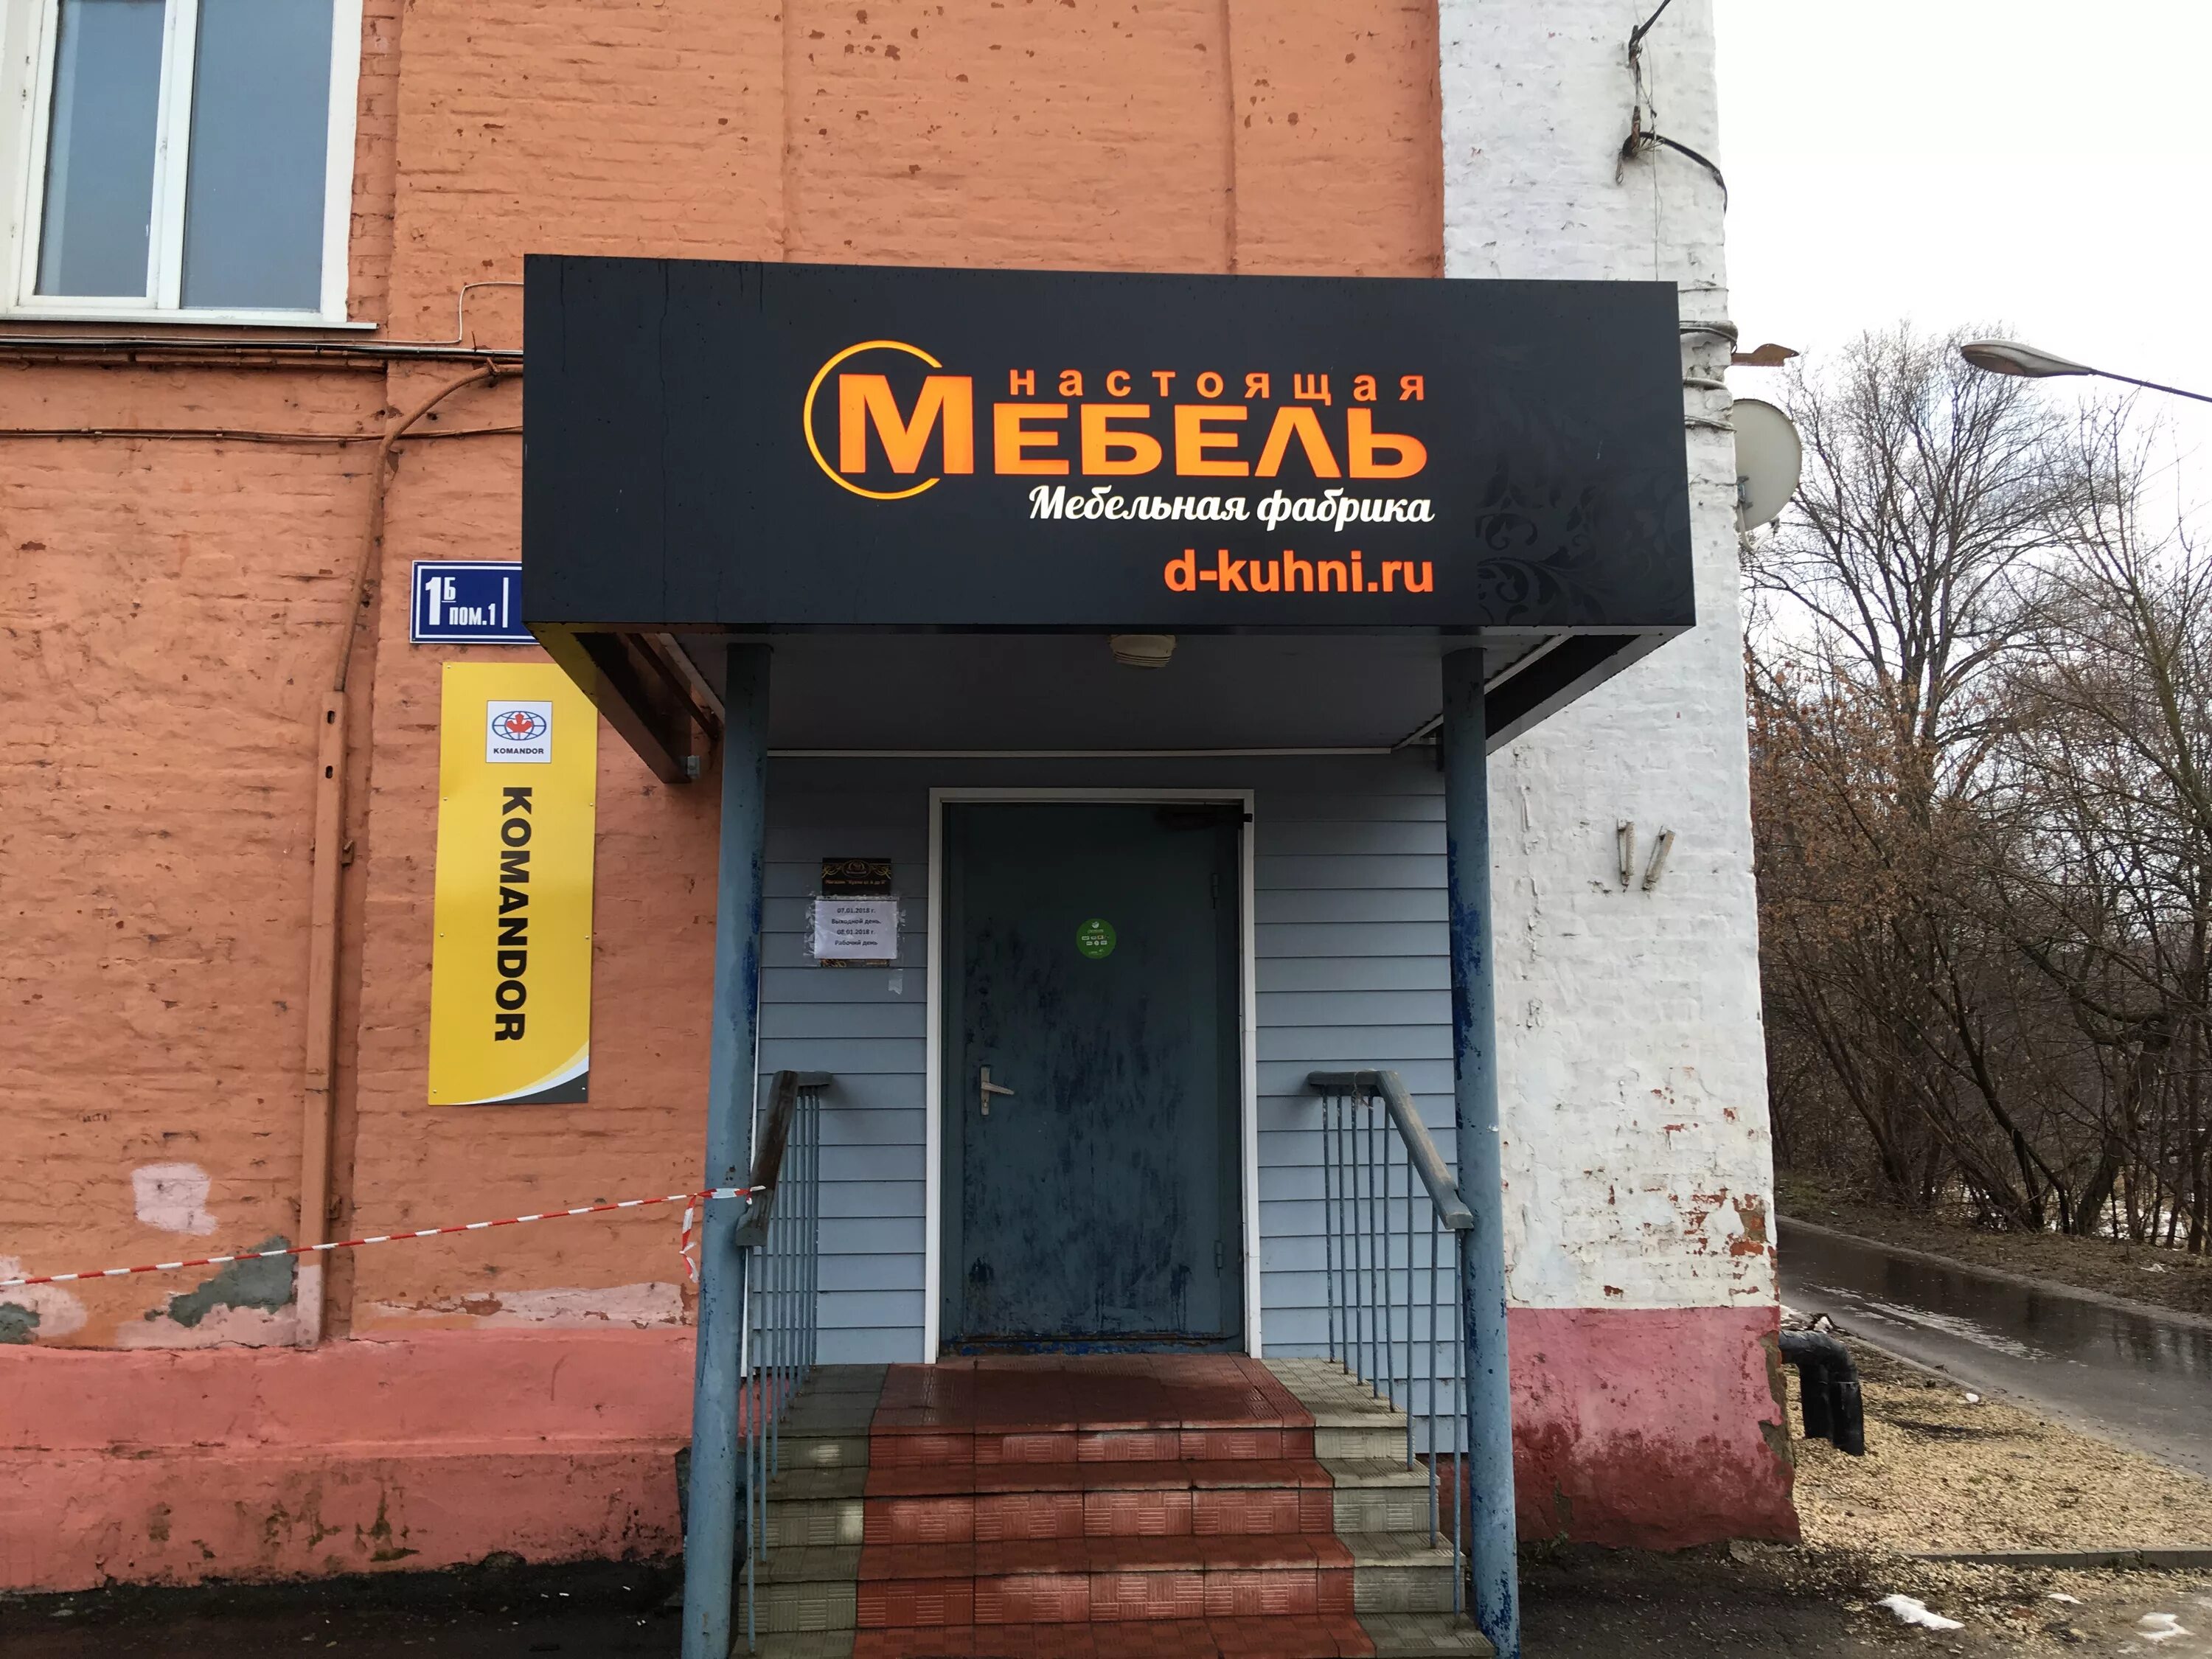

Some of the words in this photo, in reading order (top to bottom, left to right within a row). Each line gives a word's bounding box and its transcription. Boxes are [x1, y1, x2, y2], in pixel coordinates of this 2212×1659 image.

[1009, 369, 1426, 406] настоящая
[1029, 485, 1251, 522] Мебельная
[1256, 487, 1436, 532] фабрика
[1164, 549, 1434, 593] d-kuhni.ru
[495, 787, 532, 1042] KOMANDOR
